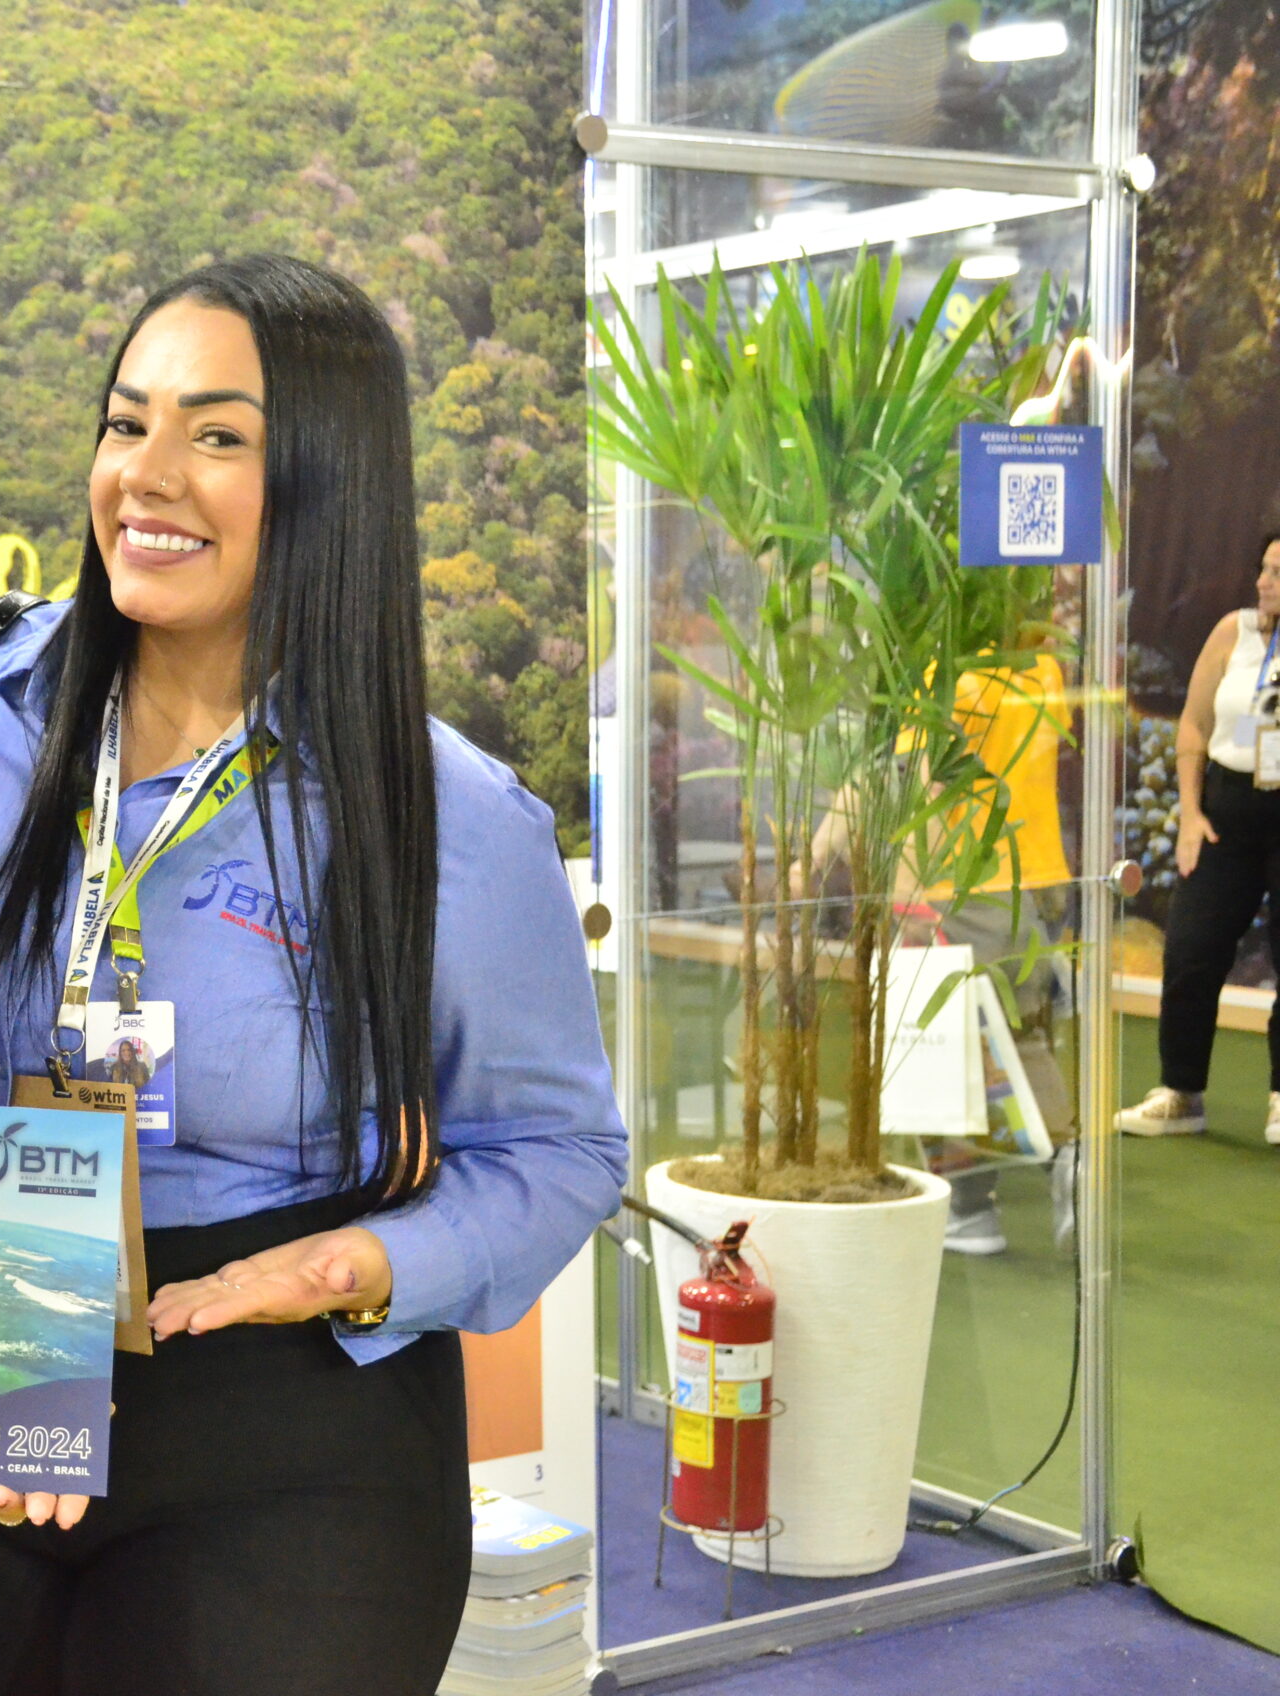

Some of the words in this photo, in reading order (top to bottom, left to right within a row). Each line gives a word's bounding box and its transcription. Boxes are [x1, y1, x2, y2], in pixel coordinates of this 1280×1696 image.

[187, 739, 232, 783] ILHABELA
[123, 1019, 145, 1028] BBC
[93, 1089, 126, 1104] wtm
[19, 1145, 99, 1176] BTM
[6, 1425, 92, 1460] 2024
[7, 1463, 42, 1474] CEARÁ
[53, 1465, 90, 1476] BRASIL
